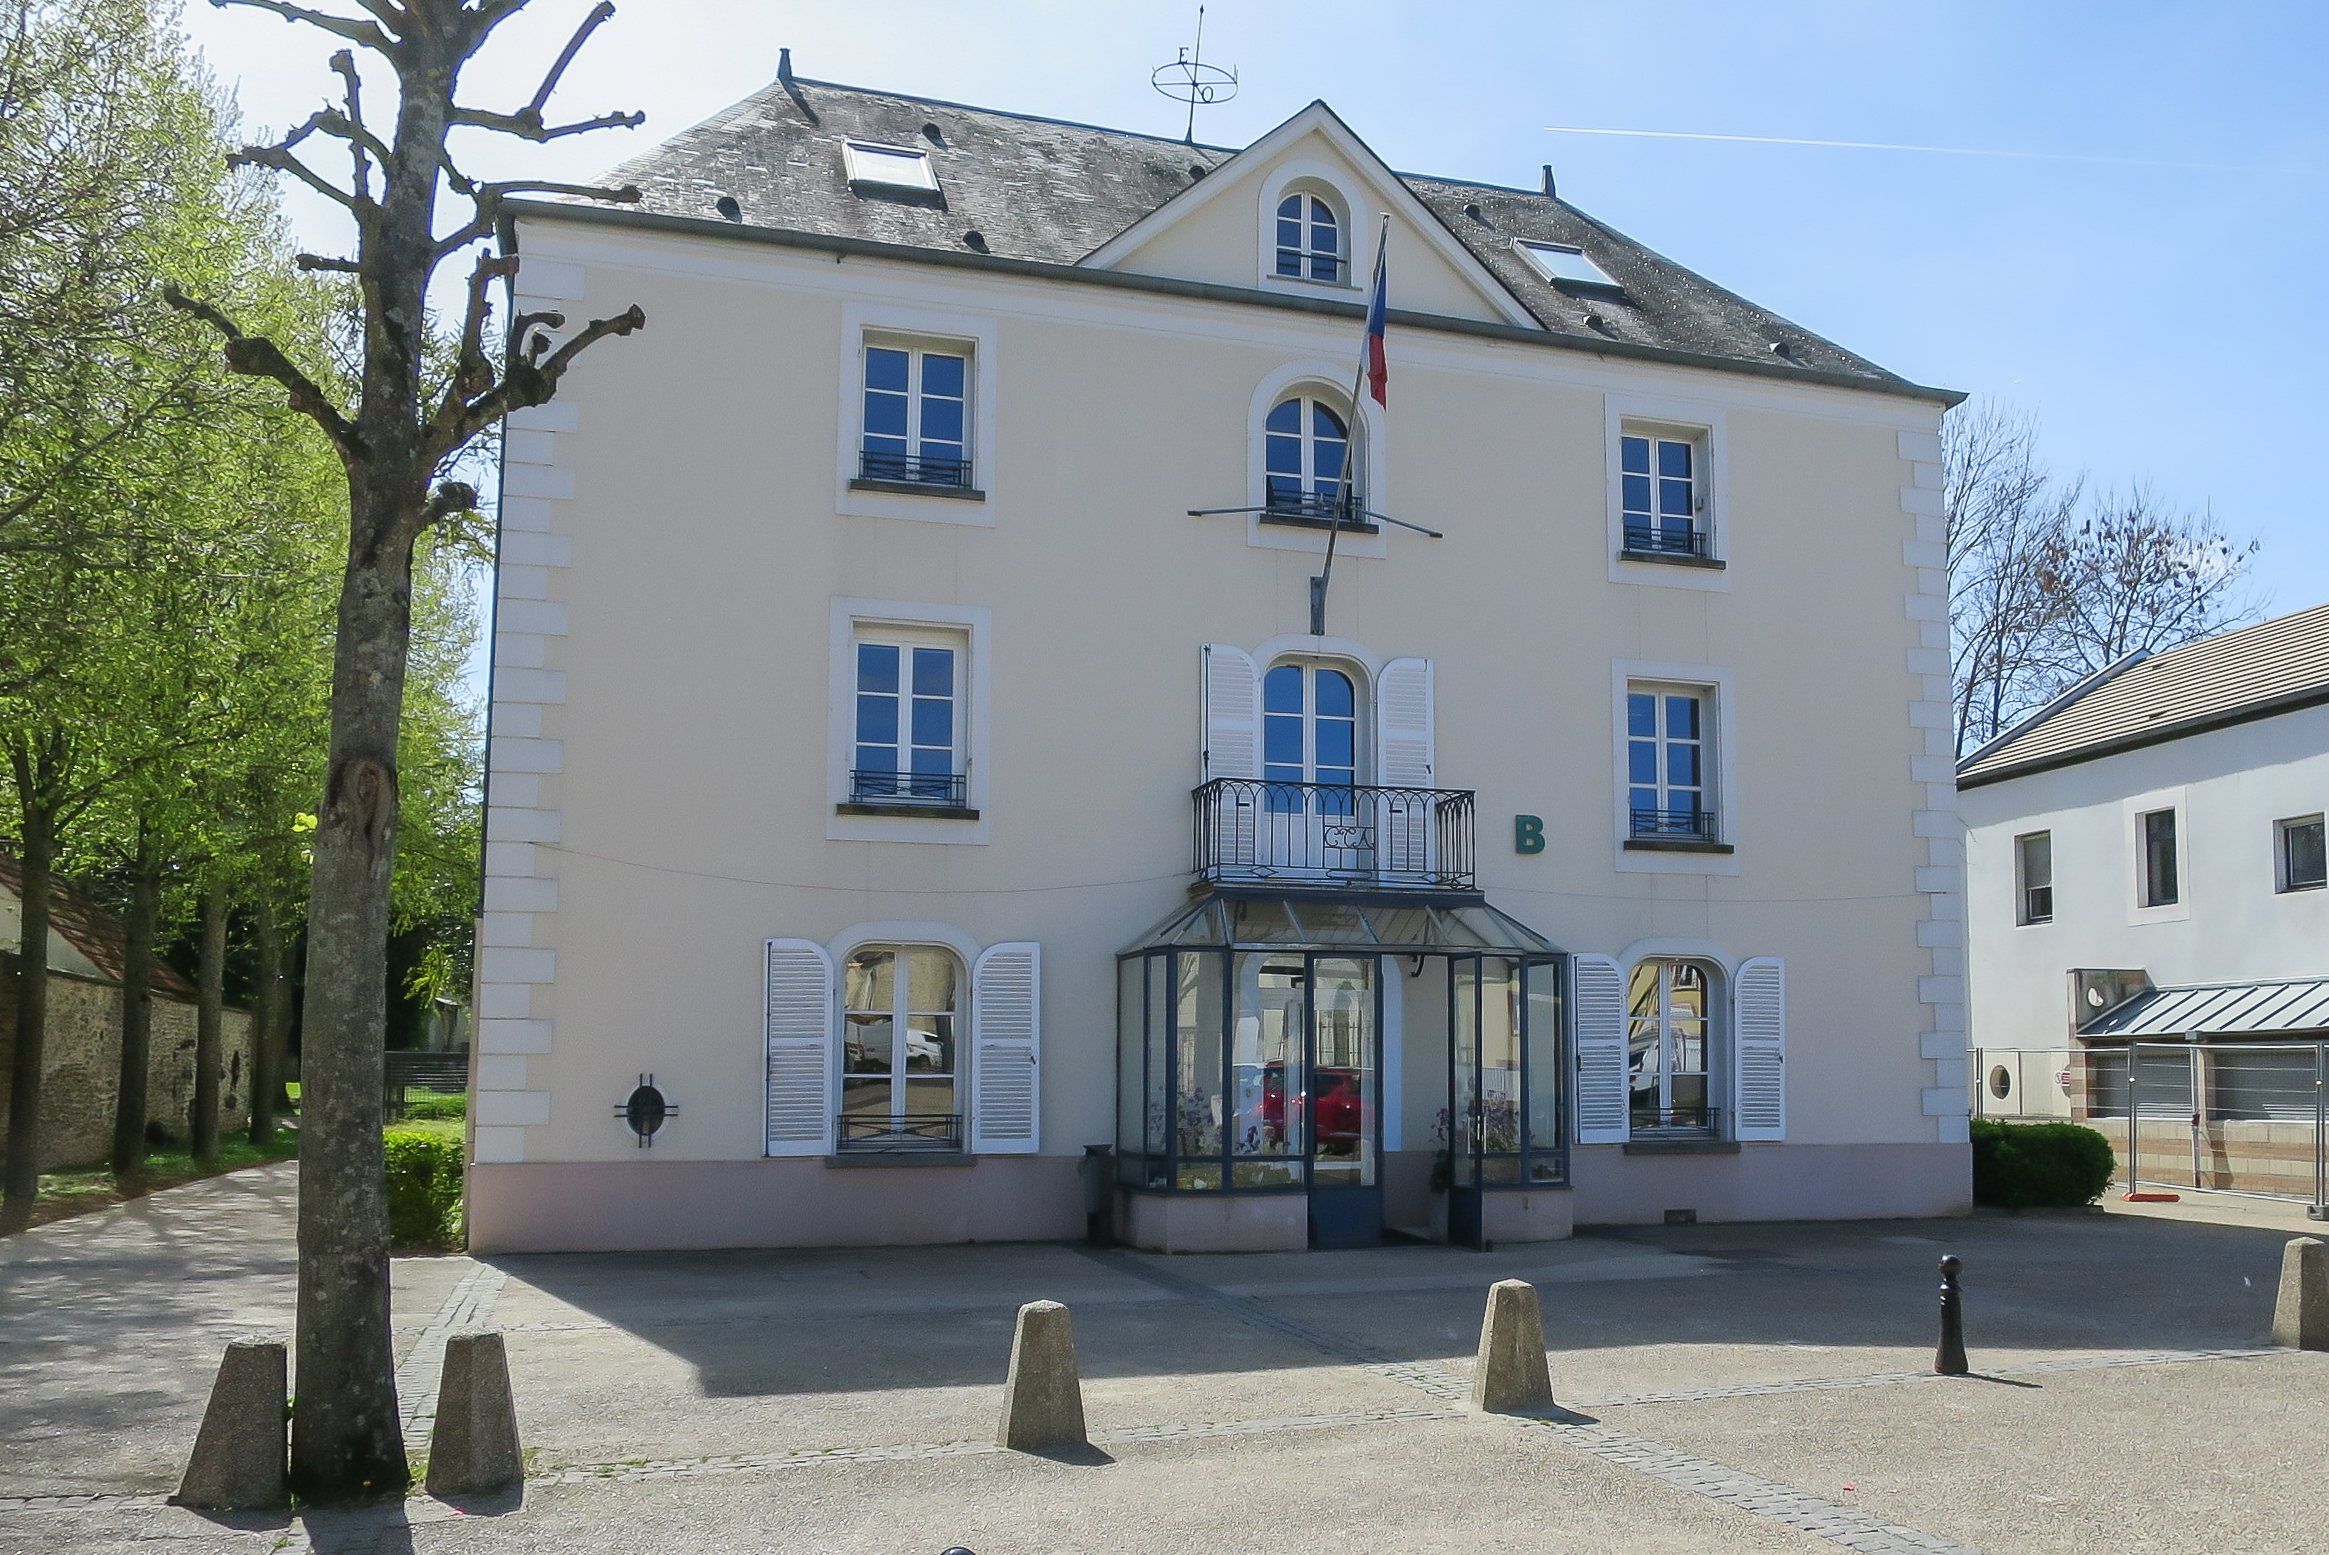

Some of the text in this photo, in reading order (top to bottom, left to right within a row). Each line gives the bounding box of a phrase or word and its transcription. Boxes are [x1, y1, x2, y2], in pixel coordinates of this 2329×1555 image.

[1178, 46, 1189, 64] E
[1202, 86, 1214, 103] O
[1515, 814, 1545, 854] B
